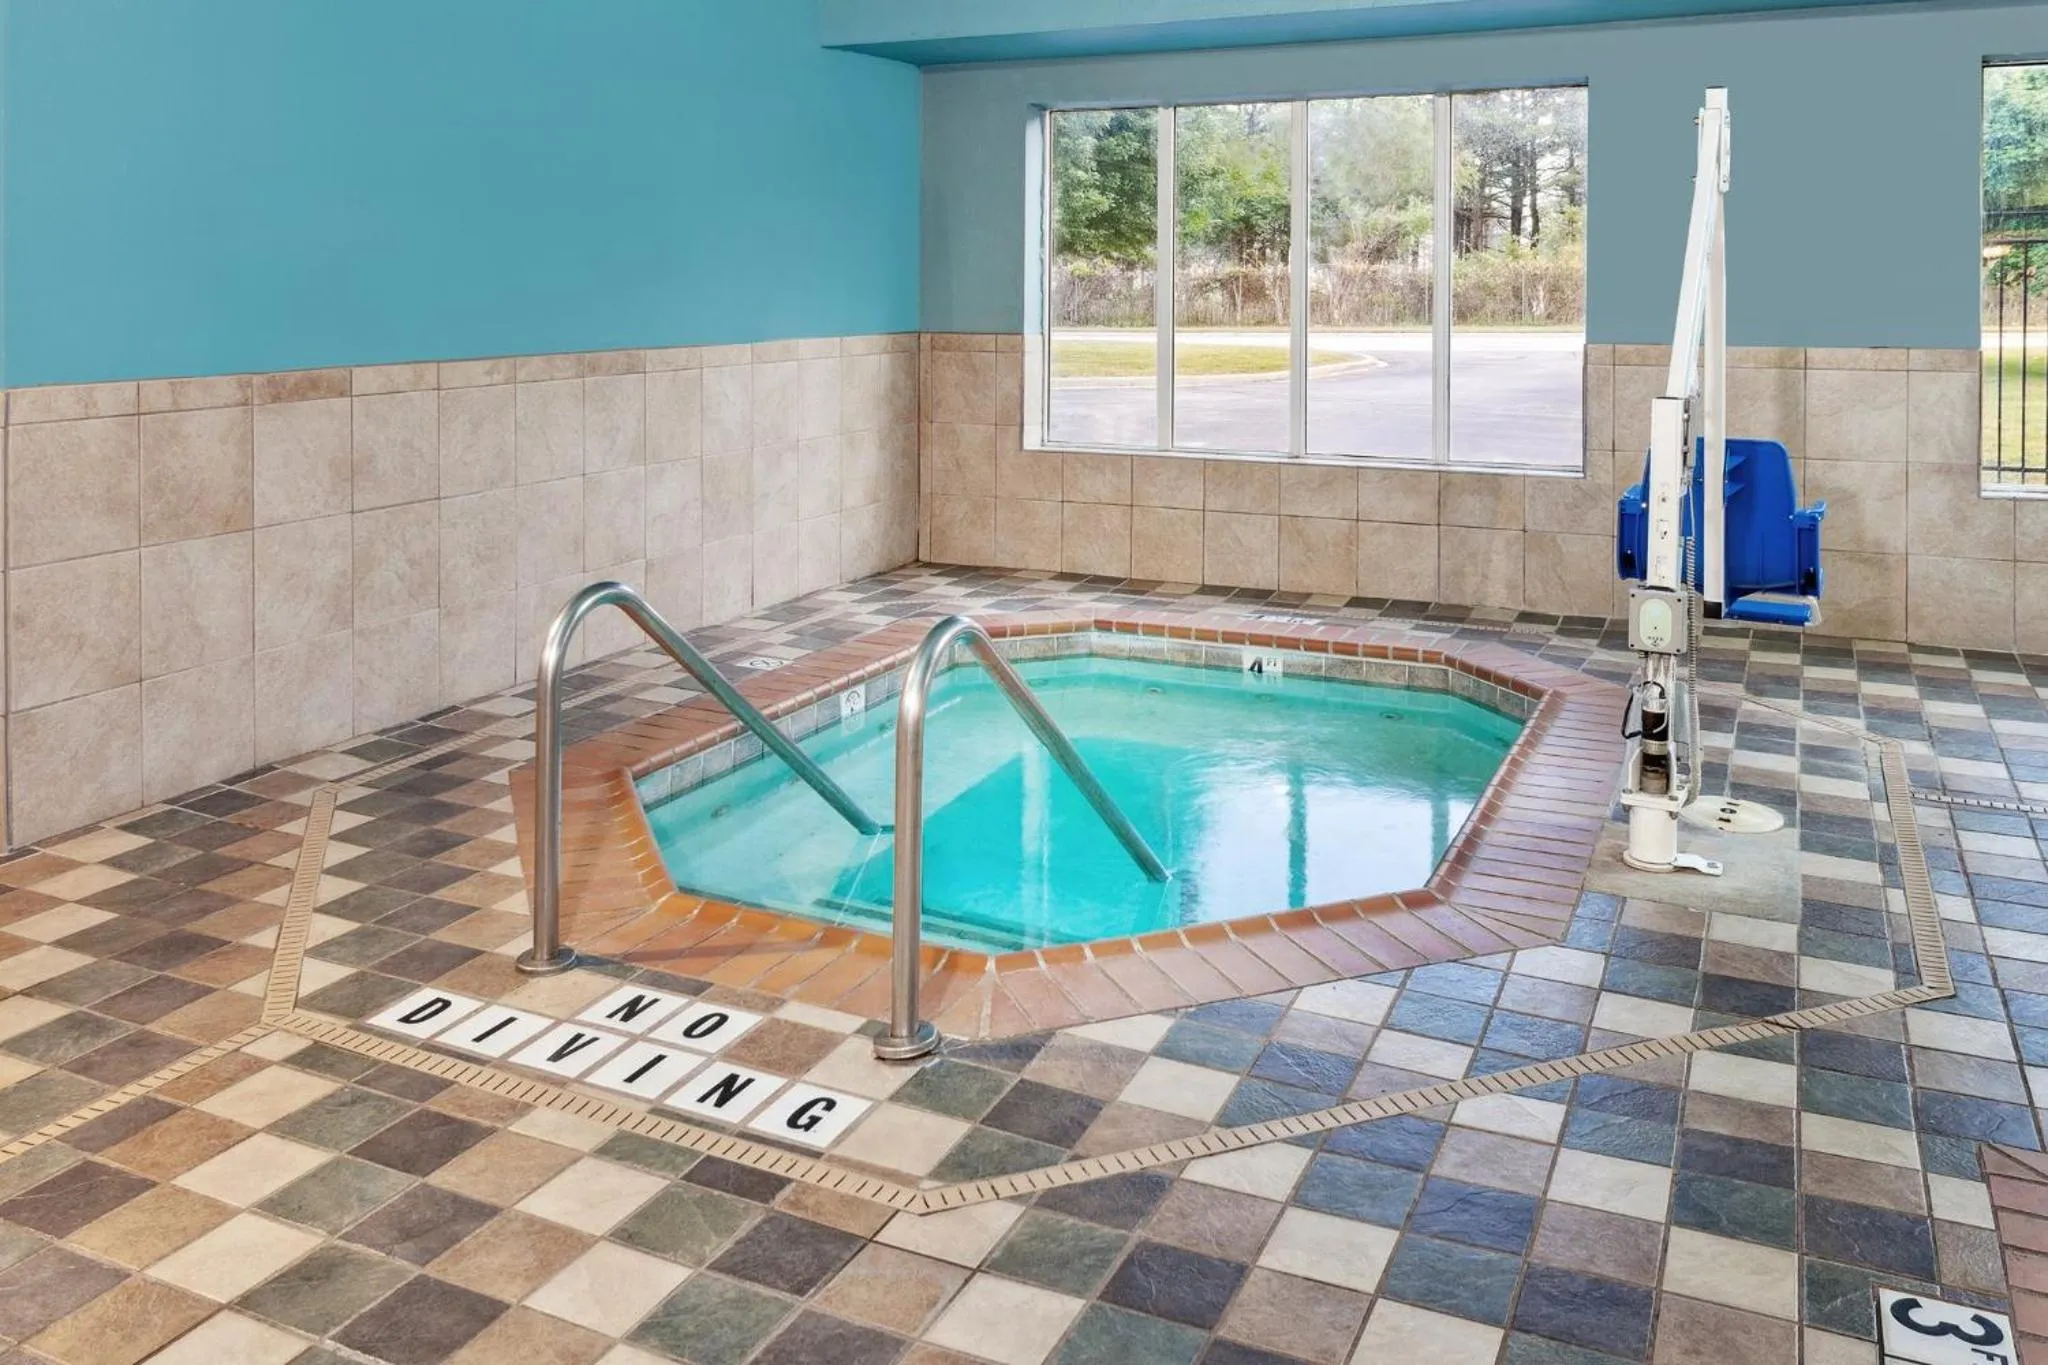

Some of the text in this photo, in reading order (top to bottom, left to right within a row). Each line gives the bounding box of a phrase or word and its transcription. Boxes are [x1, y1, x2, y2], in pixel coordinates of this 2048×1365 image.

[606, 995, 729, 1039] NO
[398, 997, 837, 1132] DIVING
[1890, 1297, 2004, 1346] 3
